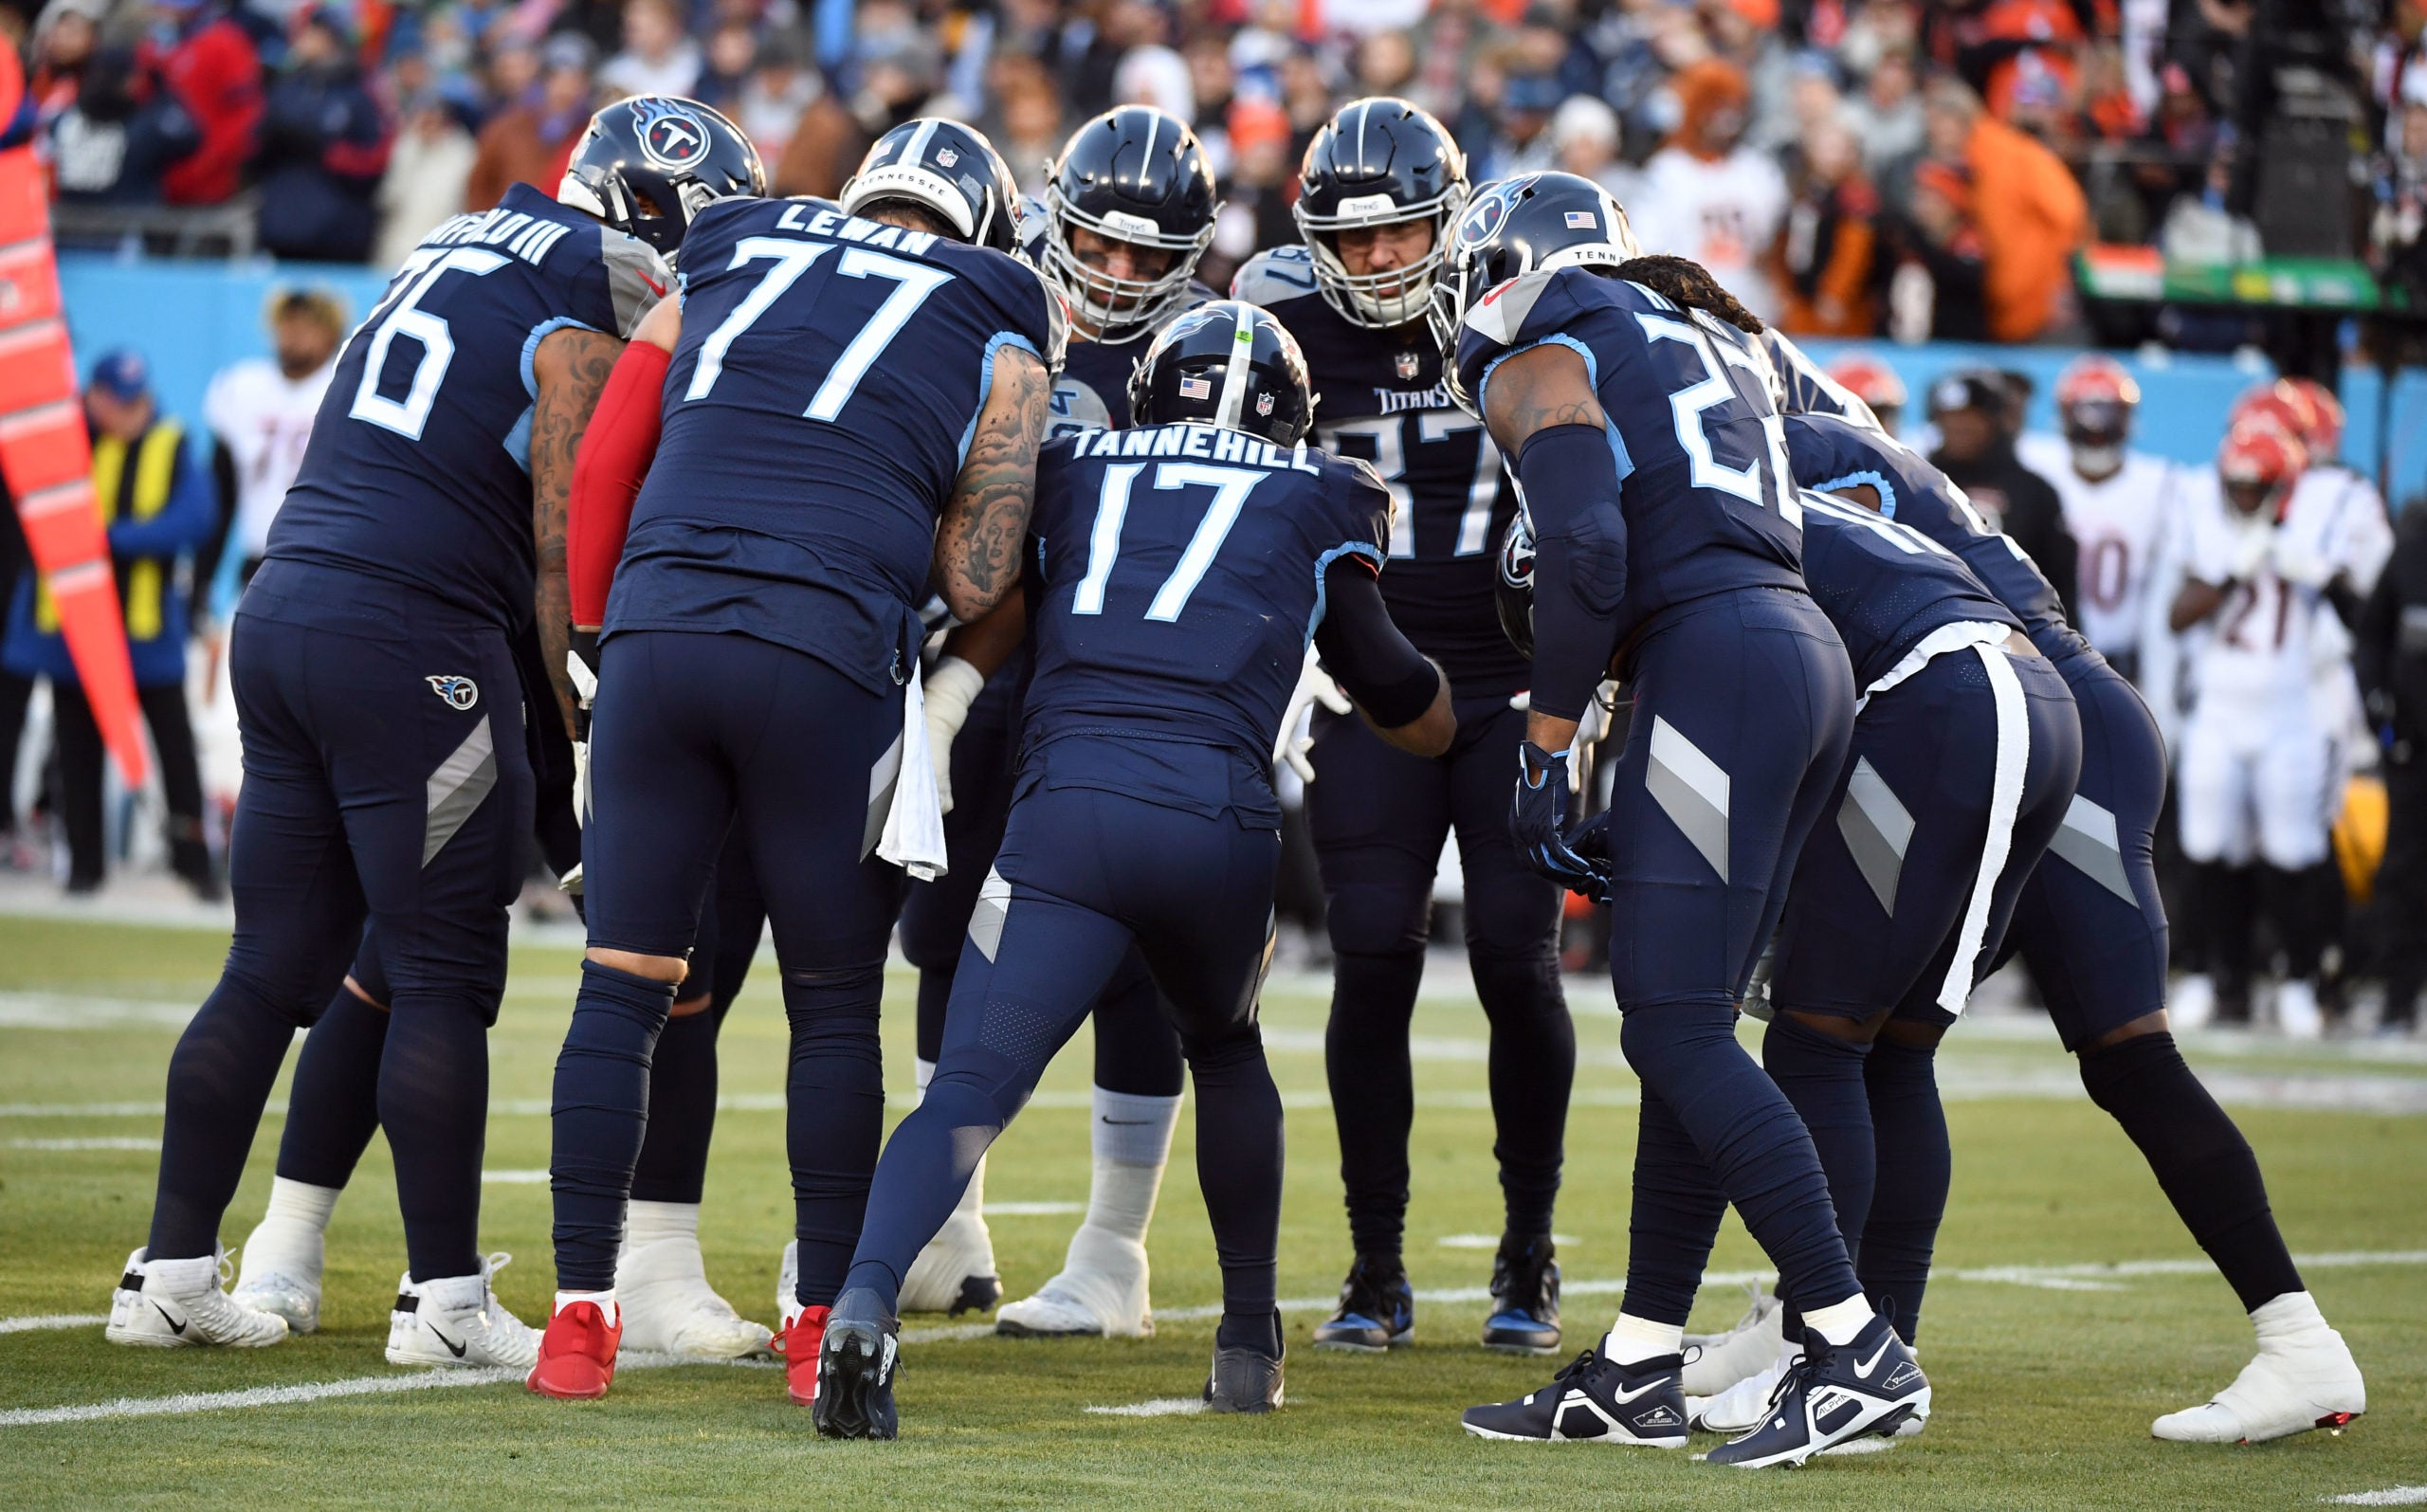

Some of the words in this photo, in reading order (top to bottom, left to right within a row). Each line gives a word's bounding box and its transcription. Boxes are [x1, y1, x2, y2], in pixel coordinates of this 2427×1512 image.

[861, 173, 946, 196] TENNESSEE
[776, 204, 940, 256] LEWAN
[684, 236, 957, 422] 77
[1373, 381, 1452, 415] TITANS
[1073, 426, 1320, 476] TANNEHILL
[1071, 462, 1273, 623] 17
[1817, 1394, 1851, 1418] ALPHA
